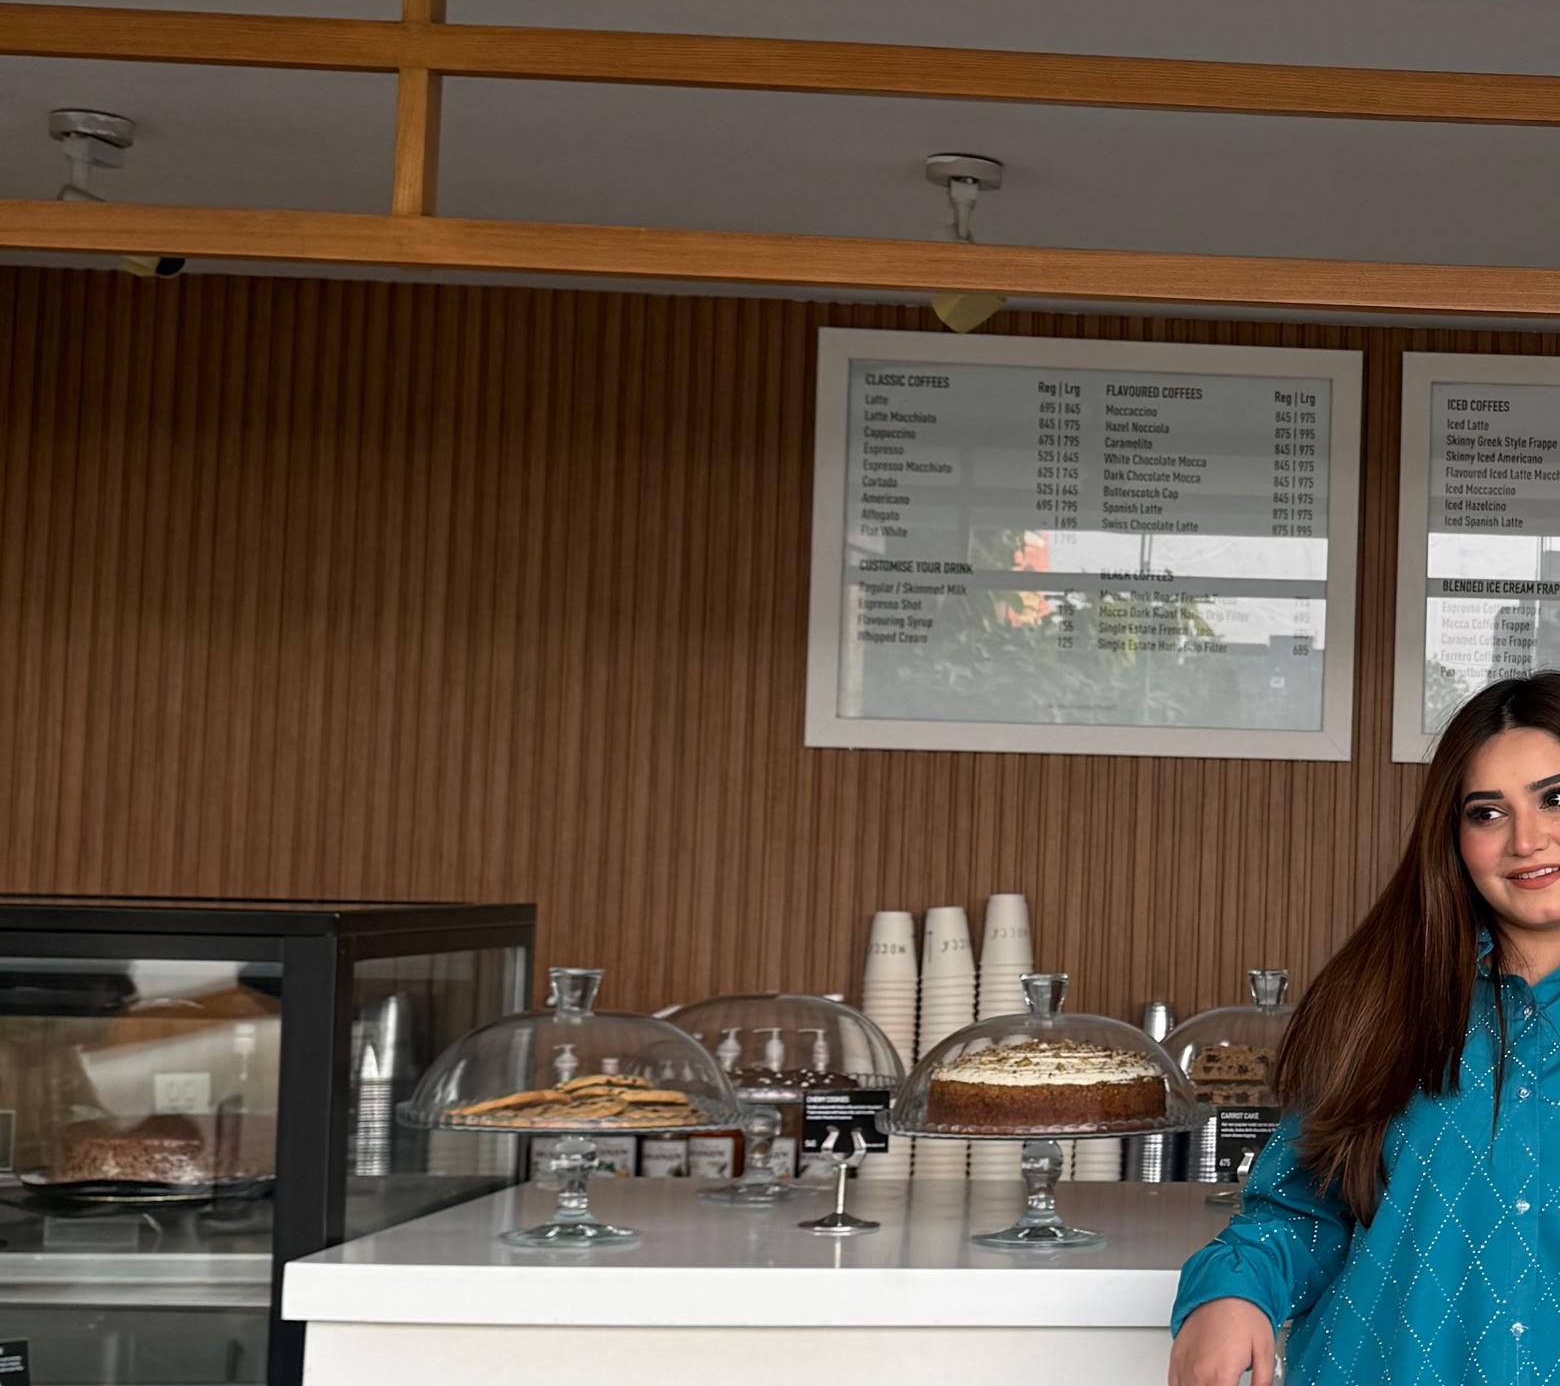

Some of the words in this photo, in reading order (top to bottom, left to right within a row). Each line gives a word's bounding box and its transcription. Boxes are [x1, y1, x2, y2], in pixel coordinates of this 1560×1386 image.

[866, 374, 906, 386] CLASSIC
[908, 376, 949, 388] COFFEES
[1038, 382, 1056, 395] Reg
[1065, 383, 1080, 397] Lrg
[1106, 384, 1160, 398] FLAVOURED
[1162, 388, 1202, 400] COFFEES
[865, 395, 888, 405] Latte
[1275, 391, 1291, 405] Reg
[1300, 392, 1315, 406] Lrg
[1106, 406, 1157, 417] Moccaccino
[1448, 400, 1467, 411] ICED
[1470, 401, 1510, 412] COFFEES
[865, 411, 887, 422] Latte
[890, 413, 936, 423] Macchiato
[1106, 422, 1129, 432] Hazel
[1132, 423, 1169, 434] Nocciola
[1447, 419, 1464, 430] Iced
[1468, 420, 1489, 431] Latte
[864, 427, 915, 439] Cappuccino
[1105, 438, 1152, 449] Caramelito
[1447, 436, 1475, 448] Skinny
[1478, 437, 1502, 447] Greek
[1505, 438, 1526, 449] Style
[1529, 438, 1557, 450] Frappe
[864, 444, 903, 455] Espresso
[1104, 454, 1130, 464] White
[1133, 454, 1176, 466] Chocolate
[1178, 457, 1206, 467] Mocca
[1446, 452, 1475, 464] Skinny
[1478, 453, 1495, 463] Iced
[1498, 454, 1543, 464] Americano
[863, 460, 903, 472] Espresso
[906, 462, 952, 473] Macchiato
[1104, 470, 1124, 481] Dark
[1127, 471, 1170, 483] Chocolate
[1173, 473, 1200, 484] Mocca
[1446, 468, 1487, 479] Flavoured
[1490, 470, 1507, 479] Iced
[1510, 470, 1532, 480] Latte
[862, 476, 897, 487] Cortado
[1103, 486, 1159, 498] Butterscotch
[1162, 489, 1178, 500] Cap
[1446, 484, 1463, 494] Iced
[1466, 485, 1515, 496] Moccaccino
[862, 493, 909, 505] Americano
[1103, 503, 1137, 514] Spanish
[1140, 504, 1162, 514] Latte
[1445, 501, 1462, 510] Iced
[1466, 501, 1506, 512] Hazelcino
[1102, 519, 1128, 530] Swiss
[1130, 520, 1173, 531] Chocolate
[1176, 521, 1198, 532] Latte
[1445, 517, 1462, 527] Iced
[1465, 518, 1499, 529] Spanish
[1502, 518, 1523, 528] Latte
[859, 559, 913, 572] CUSTOMISE
[916, 562, 941, 573] YOUR
[944, 562, 973, 574] DRINK
[1443, 581, 1483, 592] BLENDED
[1487, 582, 1500, 593] ICE
[1503, 583, 1534, 594] CREAM
